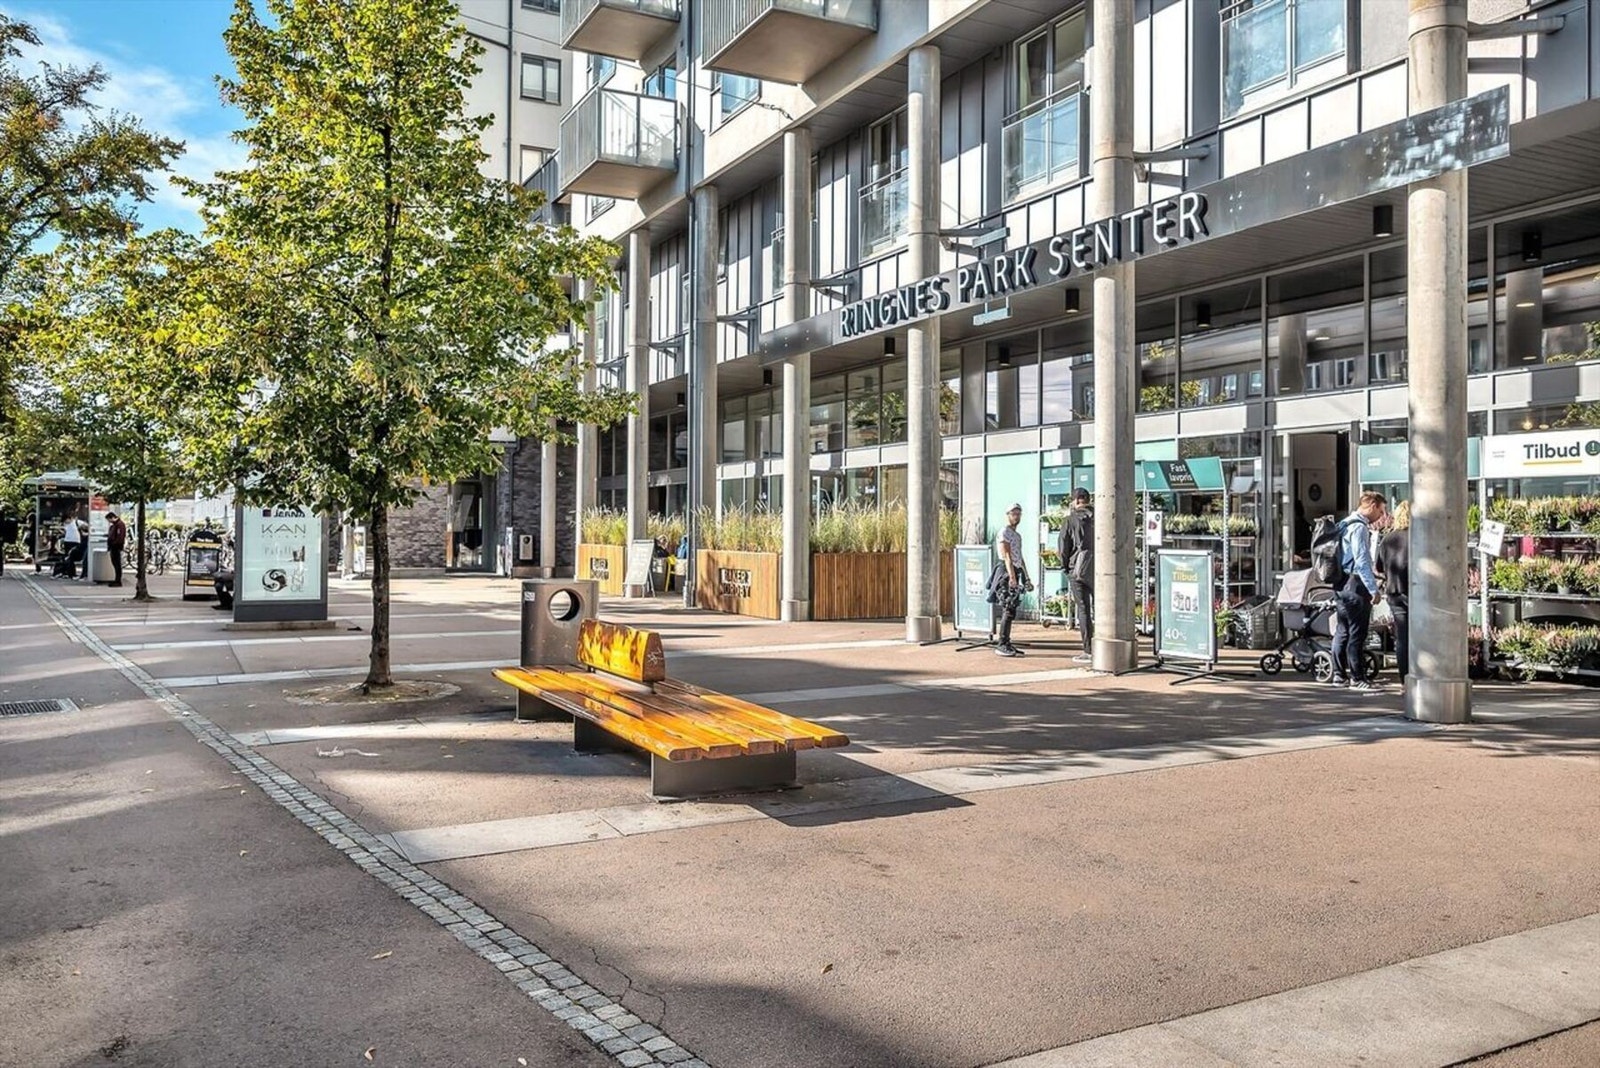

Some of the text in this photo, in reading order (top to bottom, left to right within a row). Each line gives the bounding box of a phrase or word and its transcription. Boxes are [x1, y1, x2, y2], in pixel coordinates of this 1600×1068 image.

[840, 191, 1210, 337] RINGNES PARK SENTER
[1523, 441, 1581, 459] Tilbud
[1169, 463, 1187, 472] Fast
[261, 523, 306, 534] KAN
[1171, 571, 1199, 583] Tilbud
